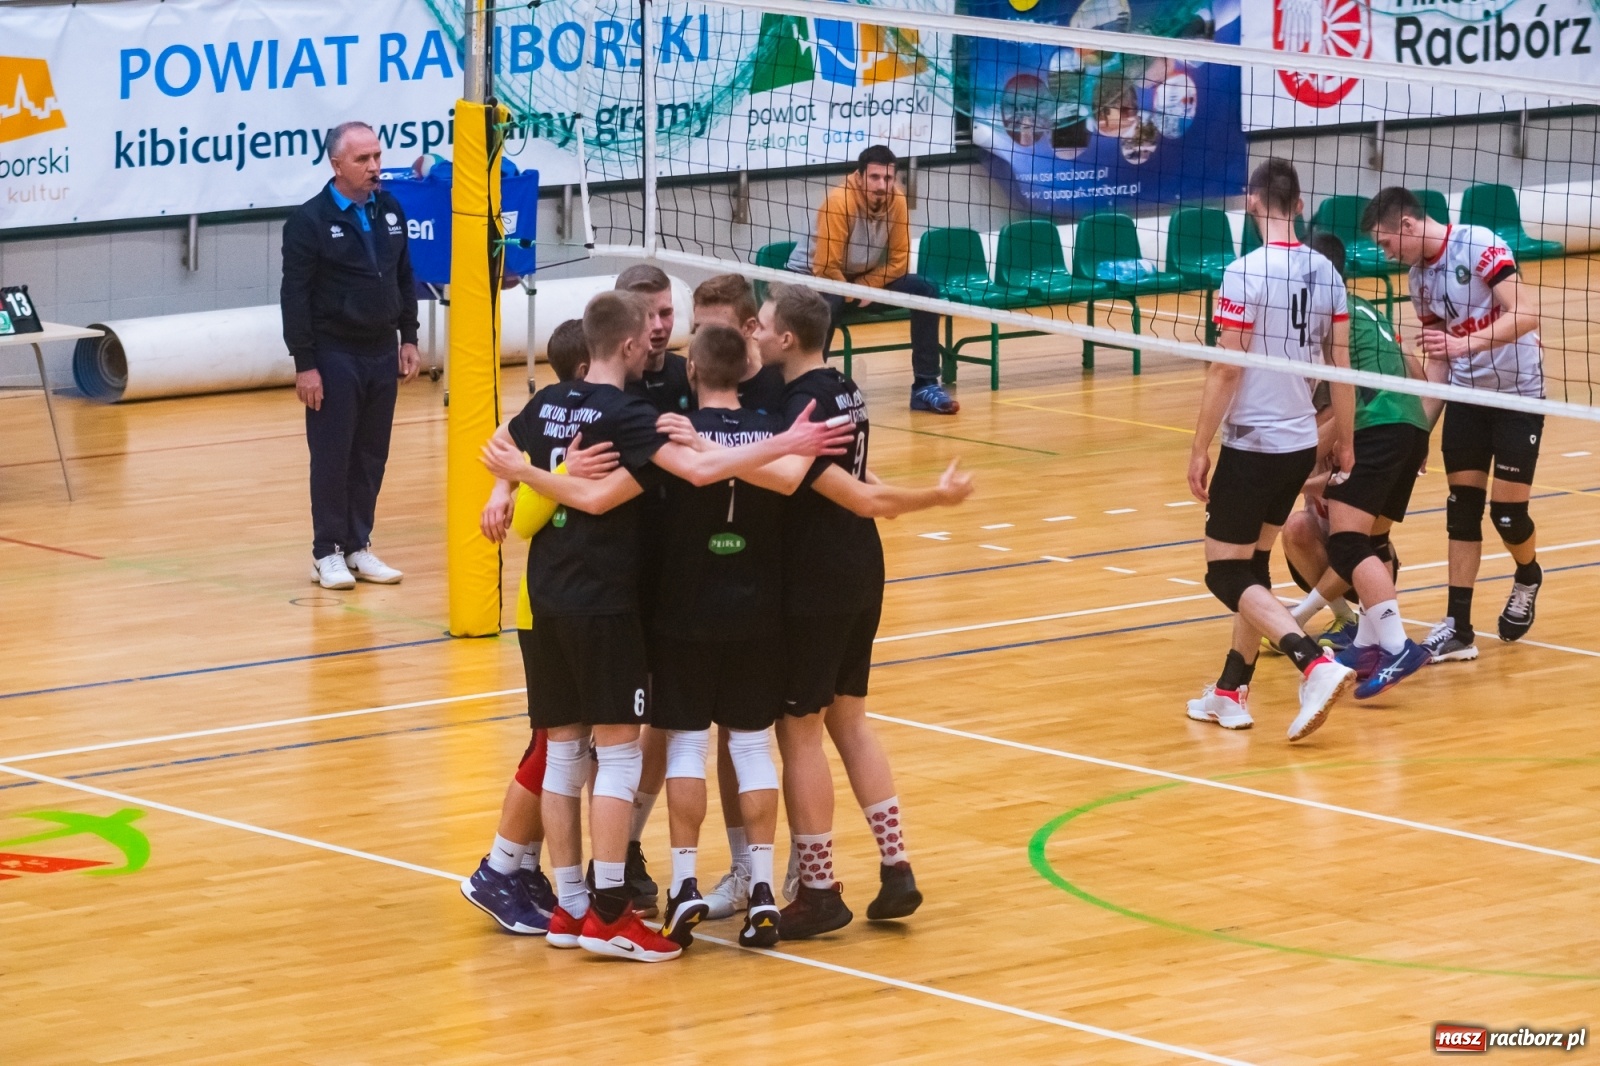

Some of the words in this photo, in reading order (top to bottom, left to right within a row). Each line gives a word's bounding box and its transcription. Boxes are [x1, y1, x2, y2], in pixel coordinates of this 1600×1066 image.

[1394, 3, 1592, 66] Racibórz
[119, 35, 359, 100] POWIAT
[379, 14, 709, 83] RAIBORSKI
[749, 98, 817, 133] powiat
[830, 90, 929, 120] raciborski
[748, 134, 808, 151] zielona
[822, 130, 865, 145] oaza
[8, 184, 70, 204] kultur
[6, 292, 32, 317] 13
[1291, 288, 1307, 347] 4
[634, 688, 645, 717] 6
